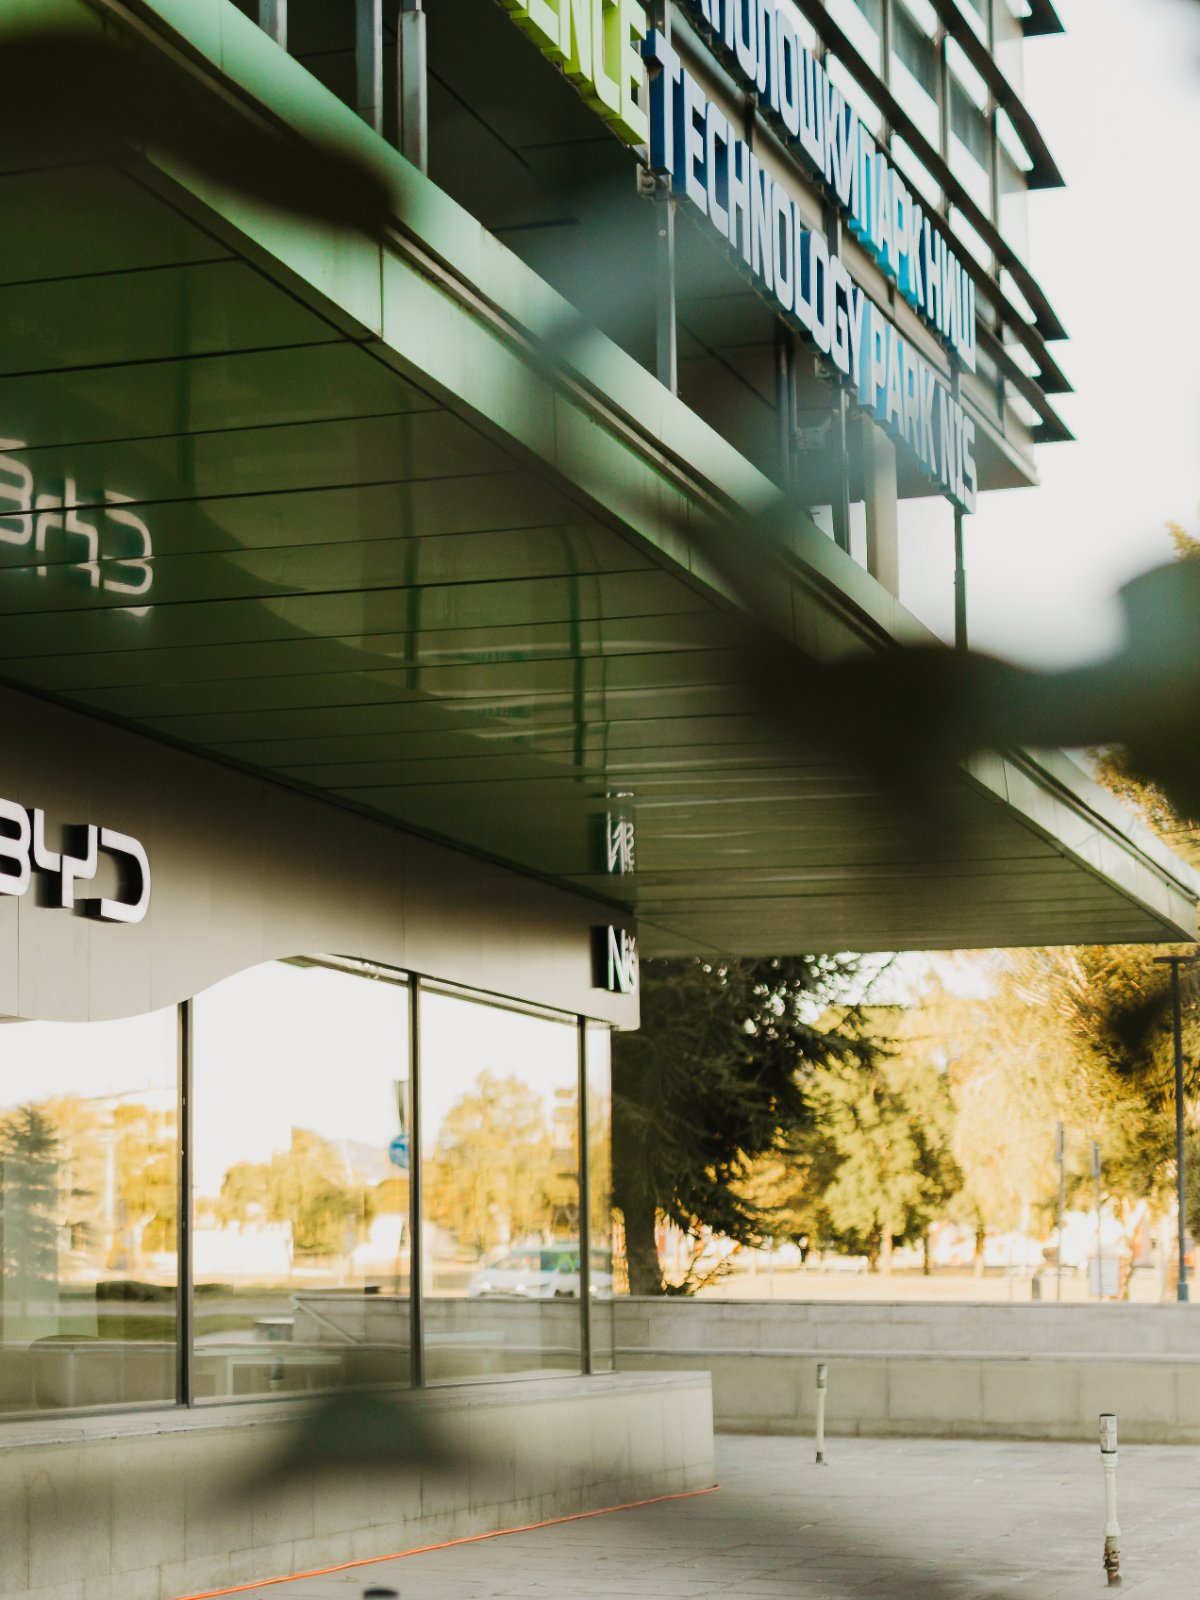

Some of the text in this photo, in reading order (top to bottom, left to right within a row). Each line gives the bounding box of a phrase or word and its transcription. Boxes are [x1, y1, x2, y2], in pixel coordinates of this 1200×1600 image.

[655, 28, 865, 388] TECHNOLOGY
[869, 301, 937, 475] PARK
[859, 121, 923, 307] ПАРК
[924, 217, 976, 373] НИШ
